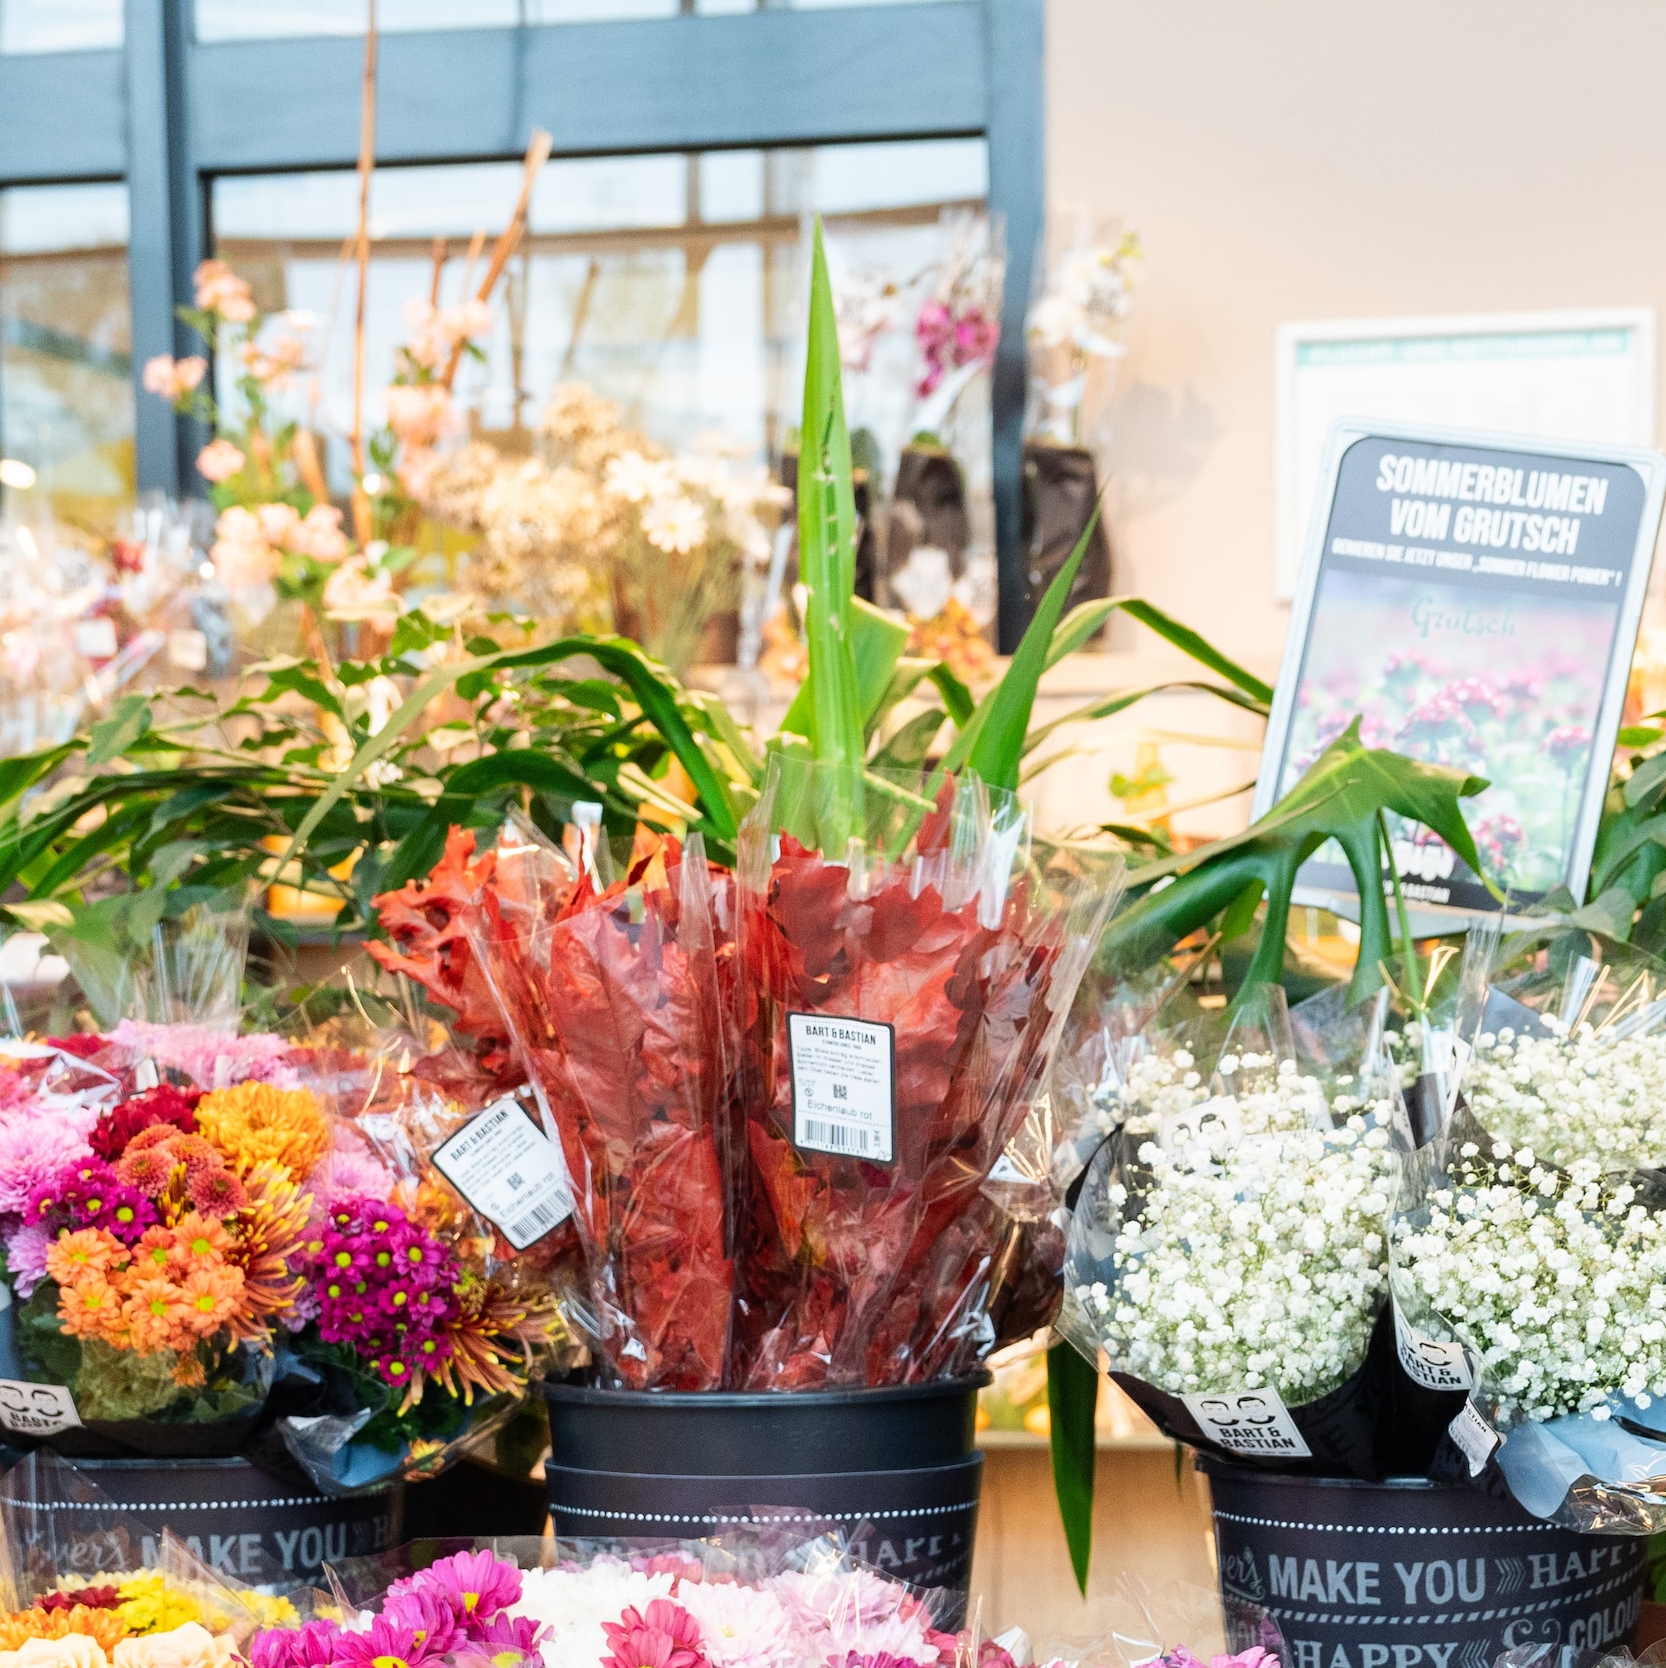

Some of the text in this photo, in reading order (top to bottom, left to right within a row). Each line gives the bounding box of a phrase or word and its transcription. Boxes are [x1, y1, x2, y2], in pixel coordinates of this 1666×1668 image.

[1377, 454, 1608, 515] SOMMERBLUMEN
[1390, 498, 1580, 555] VOM GRUTSCH
[1411, 596, 1516, 637] Grutsch
[806, 1025, 876, 1045] BART & BASTIAN
[807, 1100, 872, 1120] Eichenlaub rot
[451, 1109, 509, 1161] BART BASTIAN
[1219, 1425, 1281, 1441] BART &
[1221, 1435, 1297, 1452] BASTIAN
[142, 1526, 348, 1573] MAKE YOU
[1268, 1553, 1486, 1605] MAKE YOU
